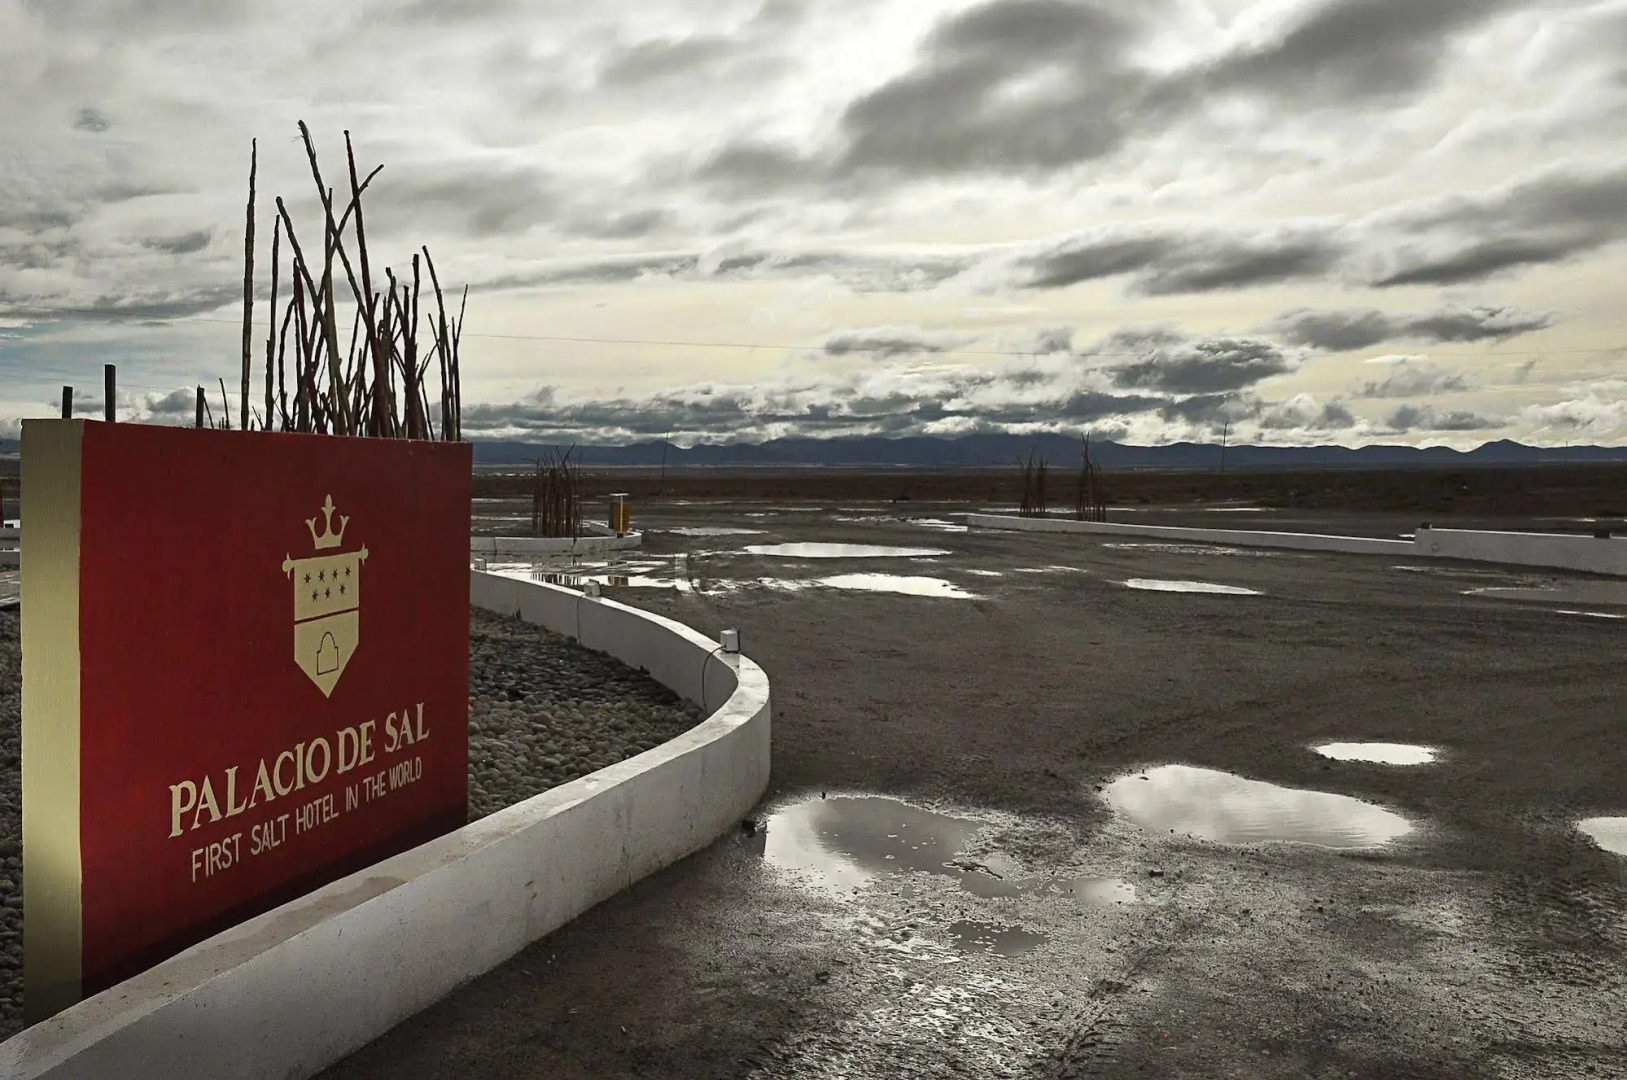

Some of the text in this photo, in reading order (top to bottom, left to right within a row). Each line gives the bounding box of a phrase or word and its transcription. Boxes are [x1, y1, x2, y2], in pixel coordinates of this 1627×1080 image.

[168, 702, 430, 839] PALACIO DE SAL
[191, 756, 422, 883] FIRST SALT HOTEL IN THE WORLD
